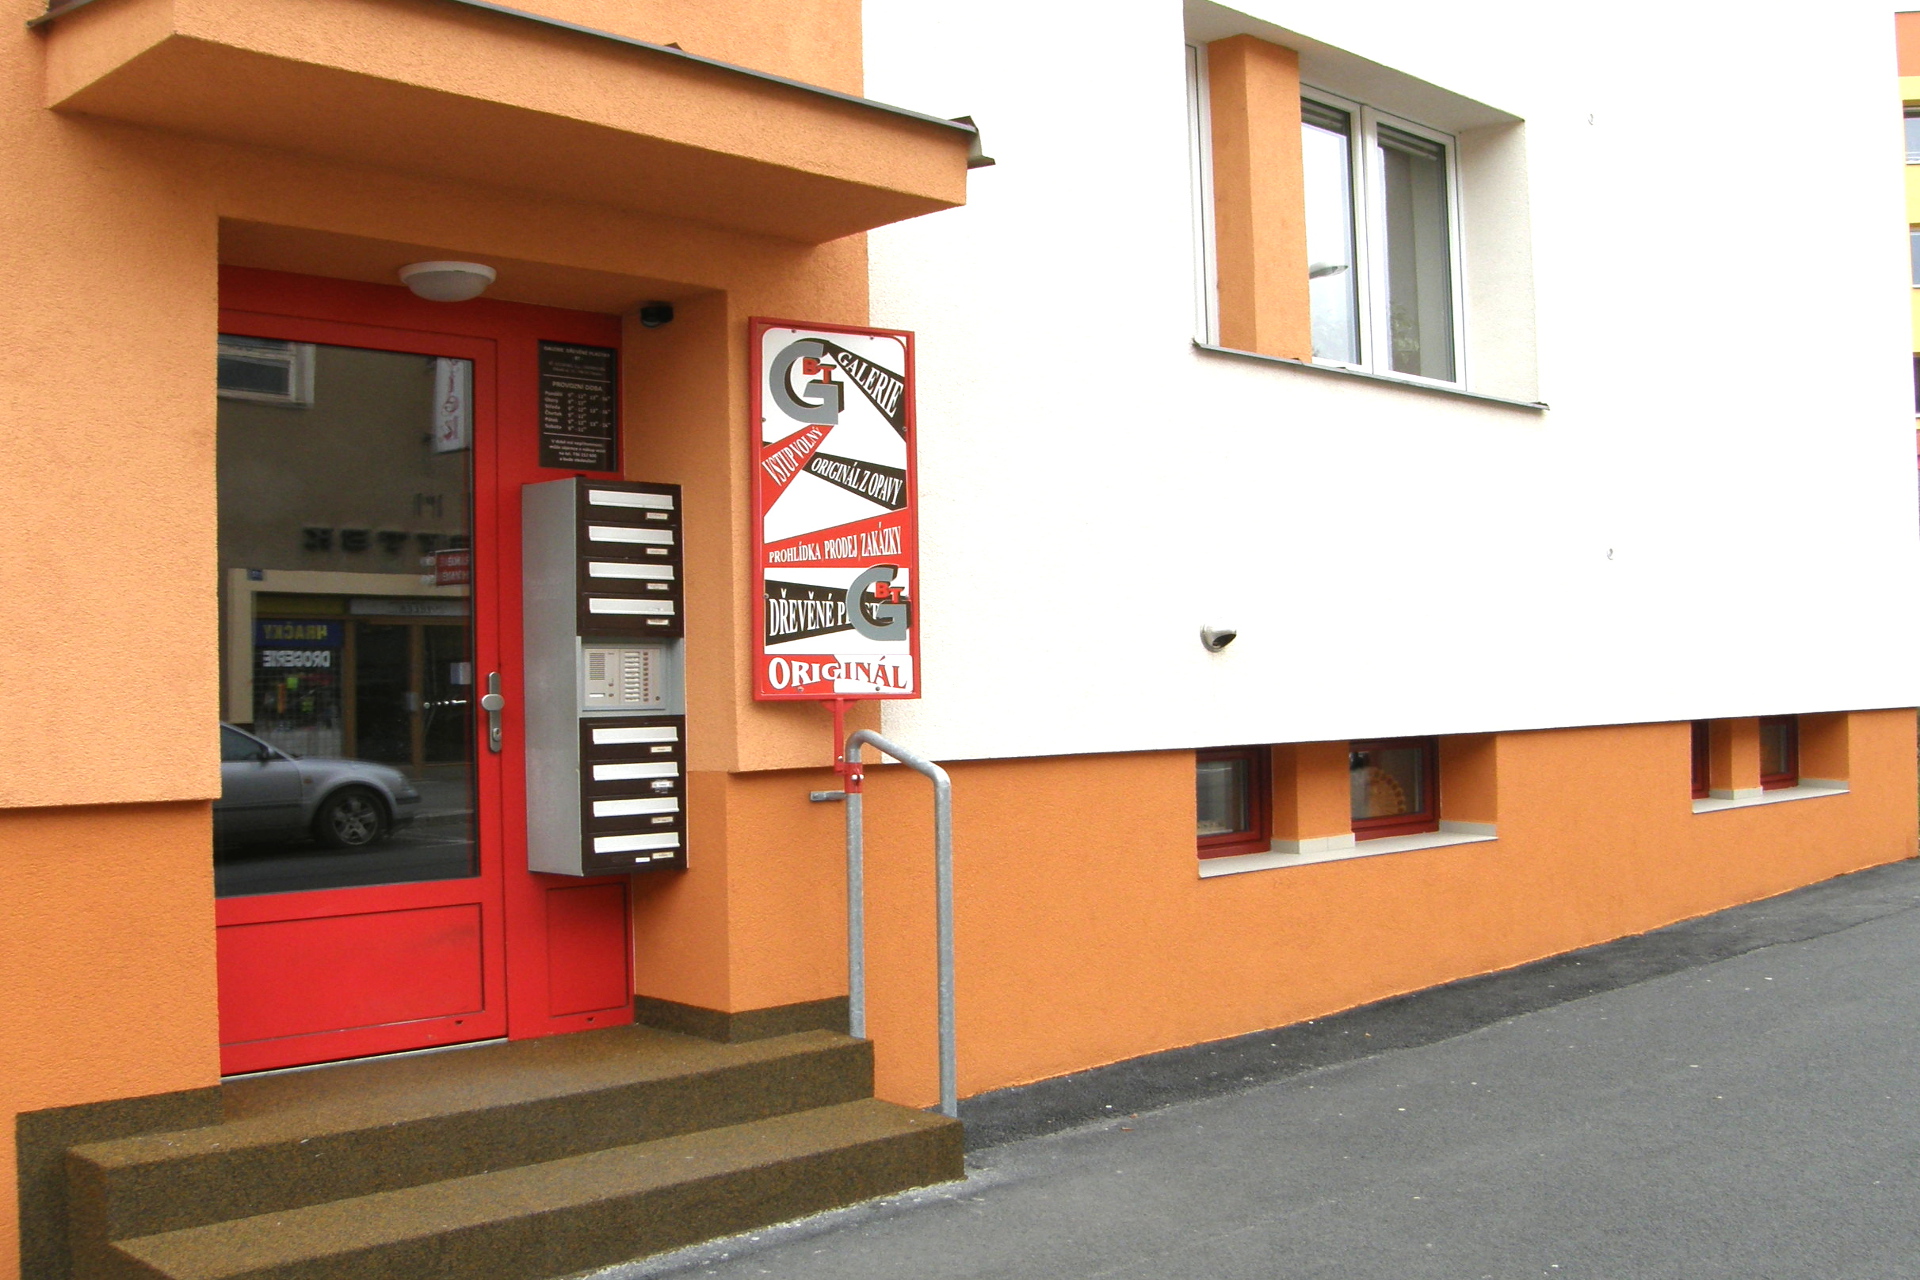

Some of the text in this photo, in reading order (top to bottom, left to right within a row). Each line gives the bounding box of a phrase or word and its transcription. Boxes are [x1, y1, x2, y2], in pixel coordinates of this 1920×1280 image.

[837, 352, 904, 418] GALERIE
[762, 426, 823, 487] VSTUP VOLNÝ
[811, 457, 903, 506] ORIGINÁL Z OPAVY
[861, 522, 902, 556] ZAKÁZKY
[769, 588, 834, 636] DŘEVĚNÉ
[768, 656, 907, 690] ORIGINÁL
